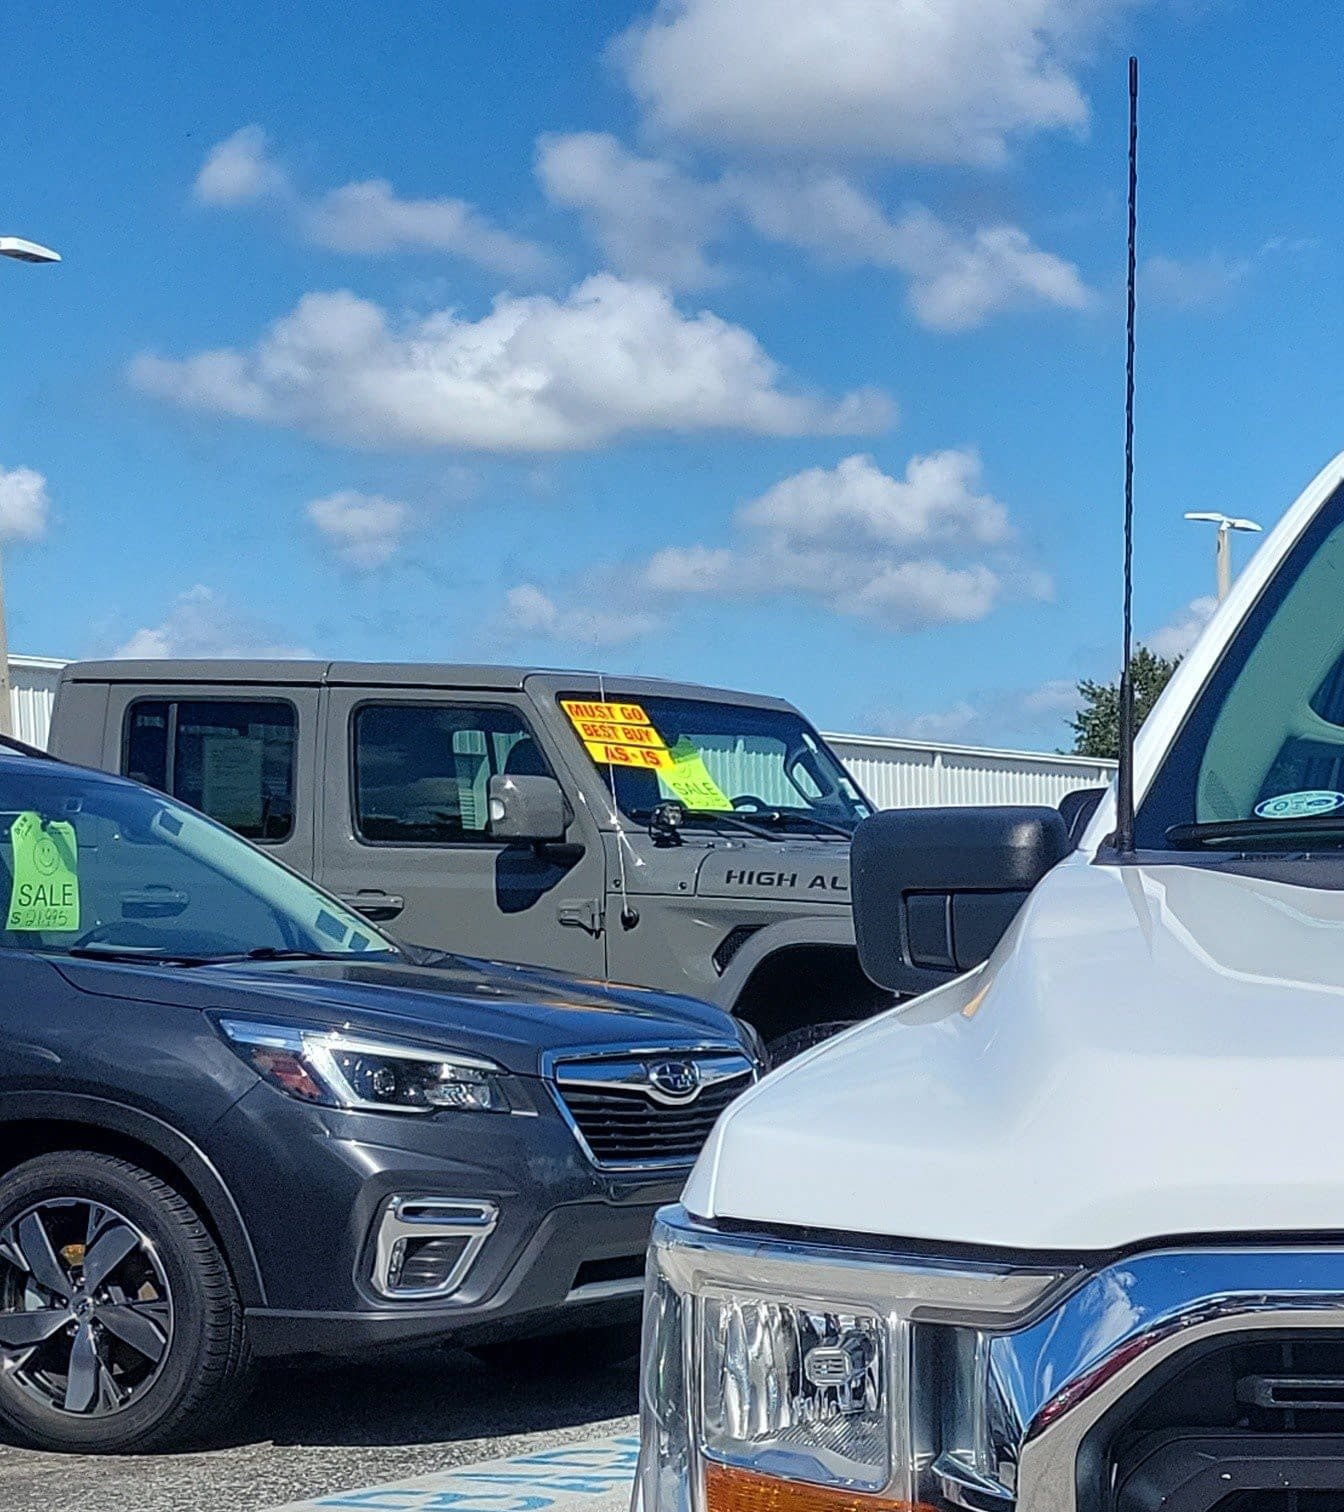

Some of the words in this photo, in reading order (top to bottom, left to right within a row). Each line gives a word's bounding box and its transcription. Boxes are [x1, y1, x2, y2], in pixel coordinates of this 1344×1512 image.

[566, 703, 615, 720] MUST
[621, 705, 644, 721] GO
[581, 723, 618, 739] BEST
[623, 726, 651, 742] BUY
[672, 782, 718, 796] SALE
[725, 869, 798, 887] HIGH
[18, 883, 73, 907] SALE
